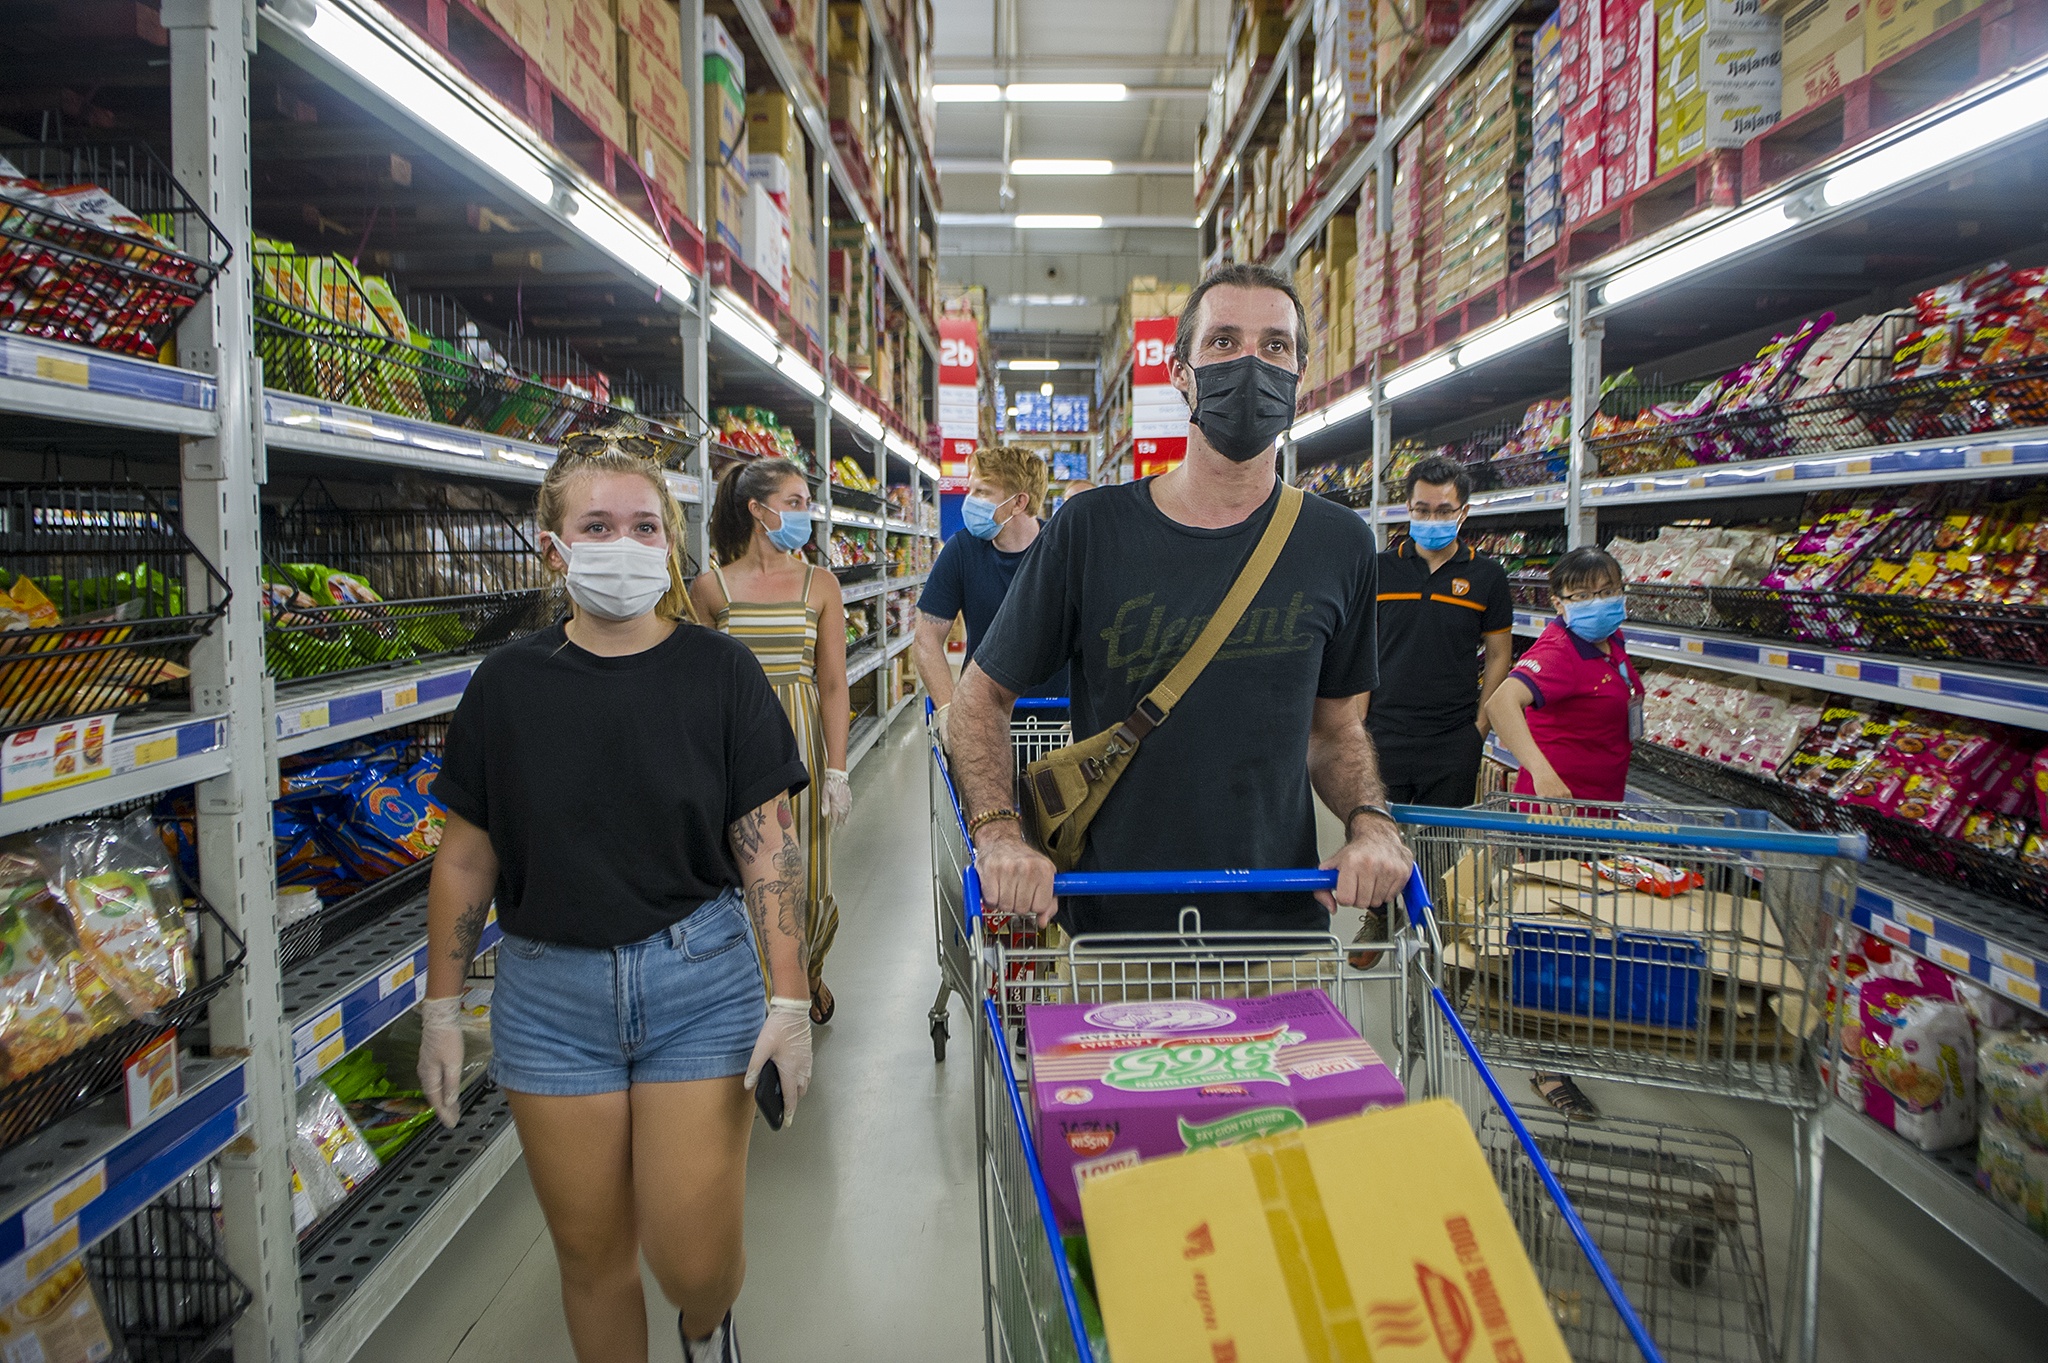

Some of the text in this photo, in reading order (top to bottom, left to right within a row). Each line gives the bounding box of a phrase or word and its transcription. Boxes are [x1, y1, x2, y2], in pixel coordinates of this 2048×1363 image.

[1100, 591, 1314, 668] Elemnt
[1110, 1044, 1274, 1080] 365
[1070, 1134, 1110, 1150] NISSIN
